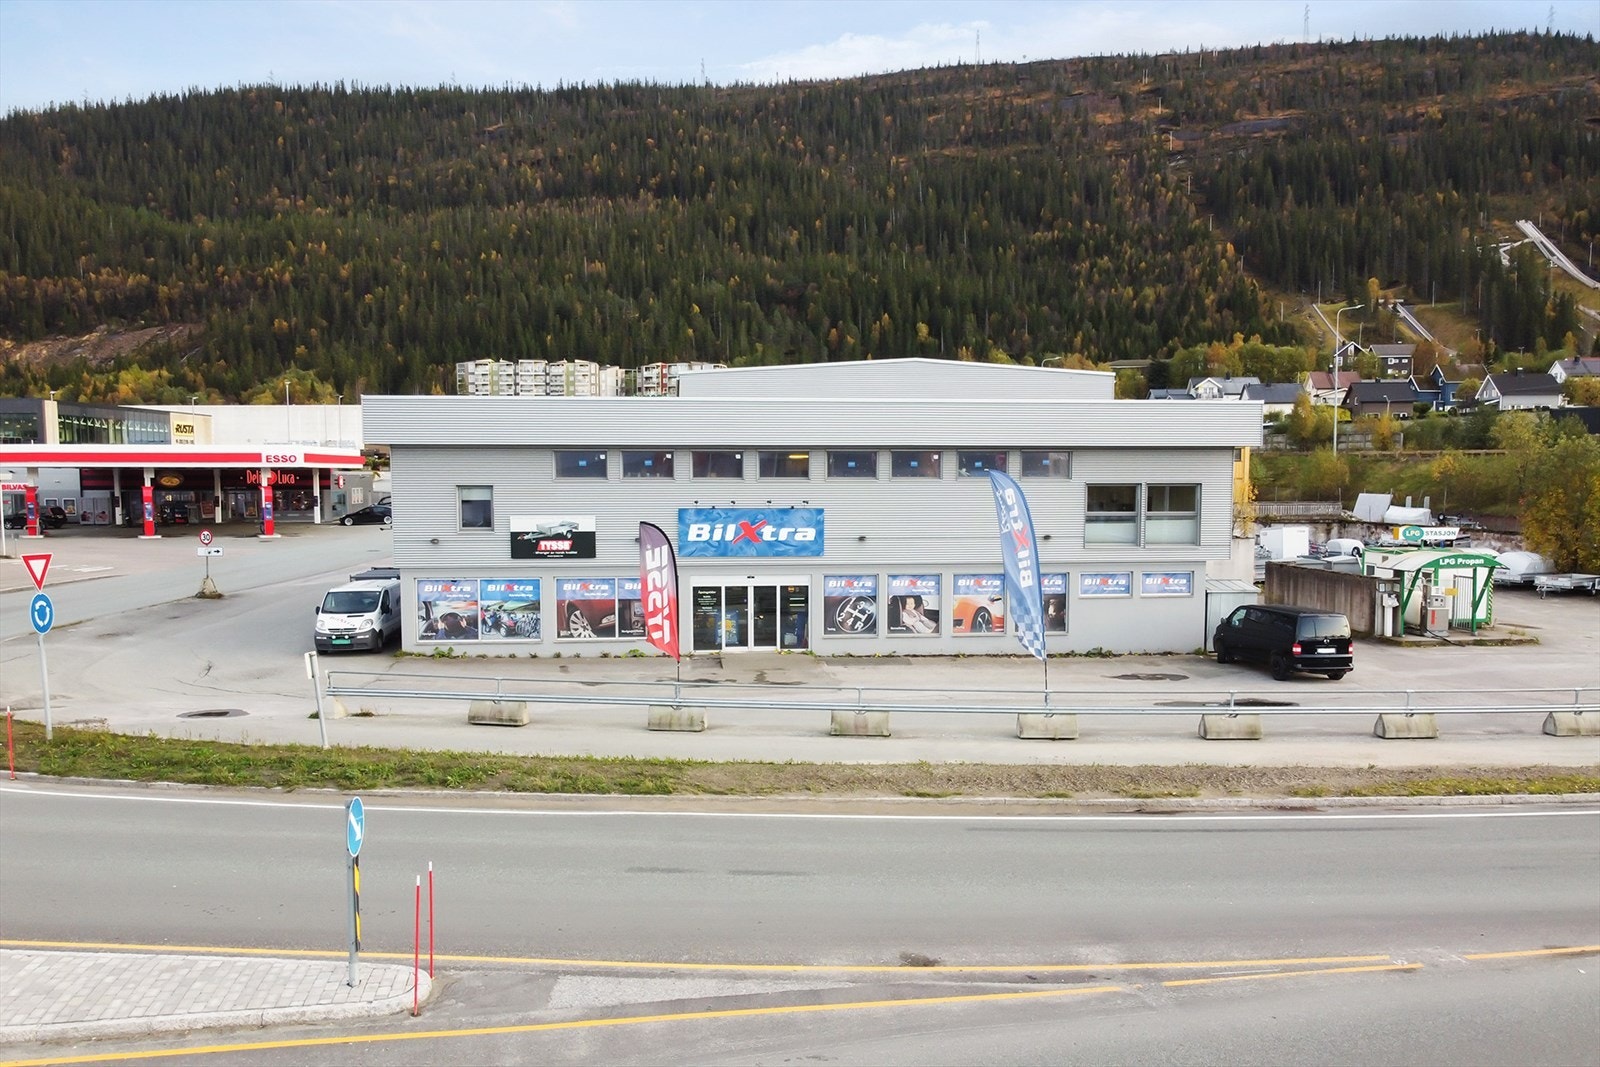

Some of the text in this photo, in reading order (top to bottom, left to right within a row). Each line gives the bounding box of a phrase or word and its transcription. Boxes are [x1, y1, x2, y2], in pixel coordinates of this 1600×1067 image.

[175, 424, 194, 433] RUSTA
[266, 455, 297, 463] ESSO
[278, 469, 295, 484] Luca
[687, 519, 816, 544] BilXtra
[202, 533, 210, 541] 30
[540, 540, 571, 550] TYSSE
[829, 579, 872, 588] BilXtra
[892, 579, 935, 587] BilXtra
[958, 577, 1001, 586] BilXtra
[1084, 577, 1126, 586] BilXtra
[1145, 576, 1186, 585] BilXtra
[424, 583, 471, 592] BilXtra
[487, 583, 533, 592] BilXtra
[563, 582, 608, 591] BilXtra
[838, 612, 845, 621] 2
[847, 617, 854, 626] 4
